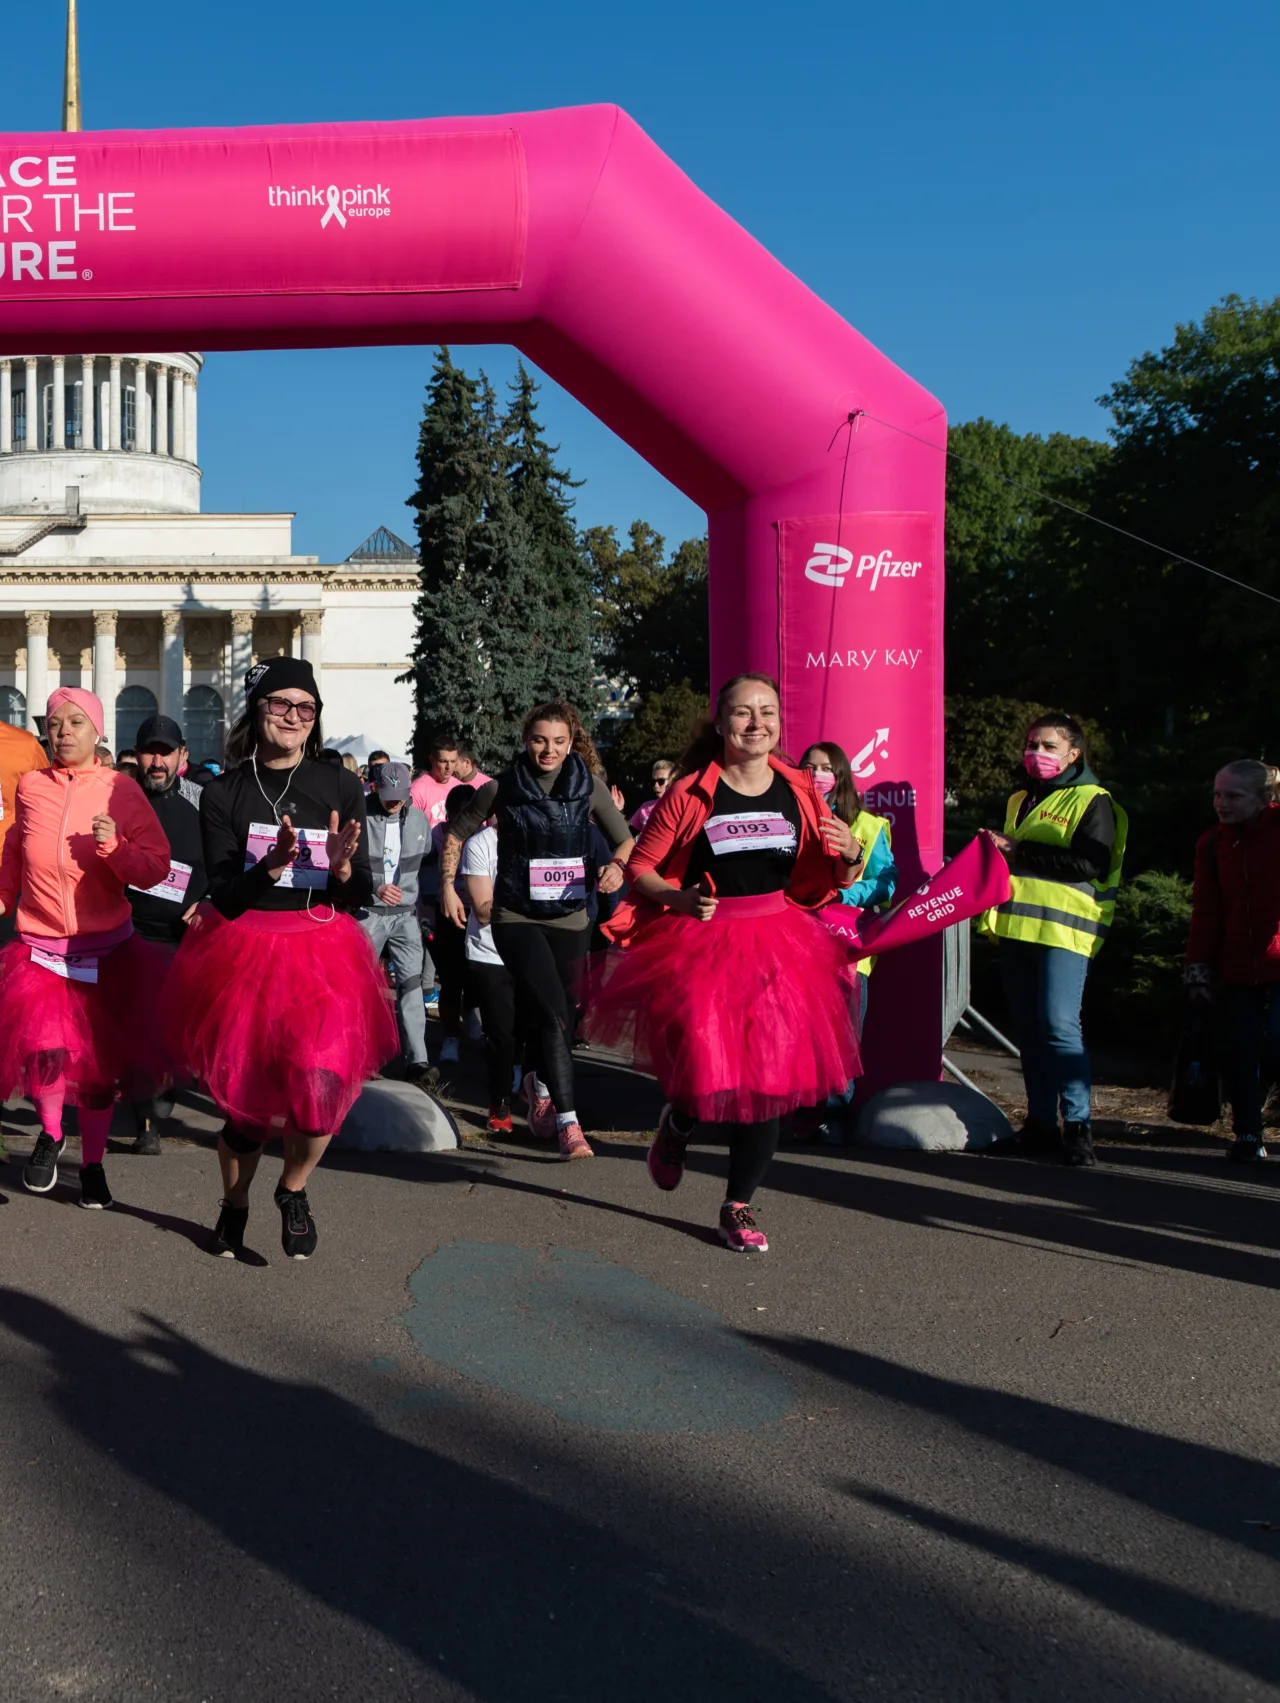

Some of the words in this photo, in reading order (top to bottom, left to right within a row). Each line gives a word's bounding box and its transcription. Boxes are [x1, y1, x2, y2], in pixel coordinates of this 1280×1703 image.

[268, 185, 325, 206] think
[342, 184, 390, 211] pink
[43, 192, 136, 232] THE
[348, 207, 391, 218] europe
[856, 550, 922, 591] Pfizer
[805, 649, 876, 670] MARY
[857, 789, 917, 808] ENUE
[727, 823, 770, 834] 0193
[544, 870, 575, 882] 0019
[907, 886, 964, 919] REVENUE
[926, 903, 955, 922] GRID
